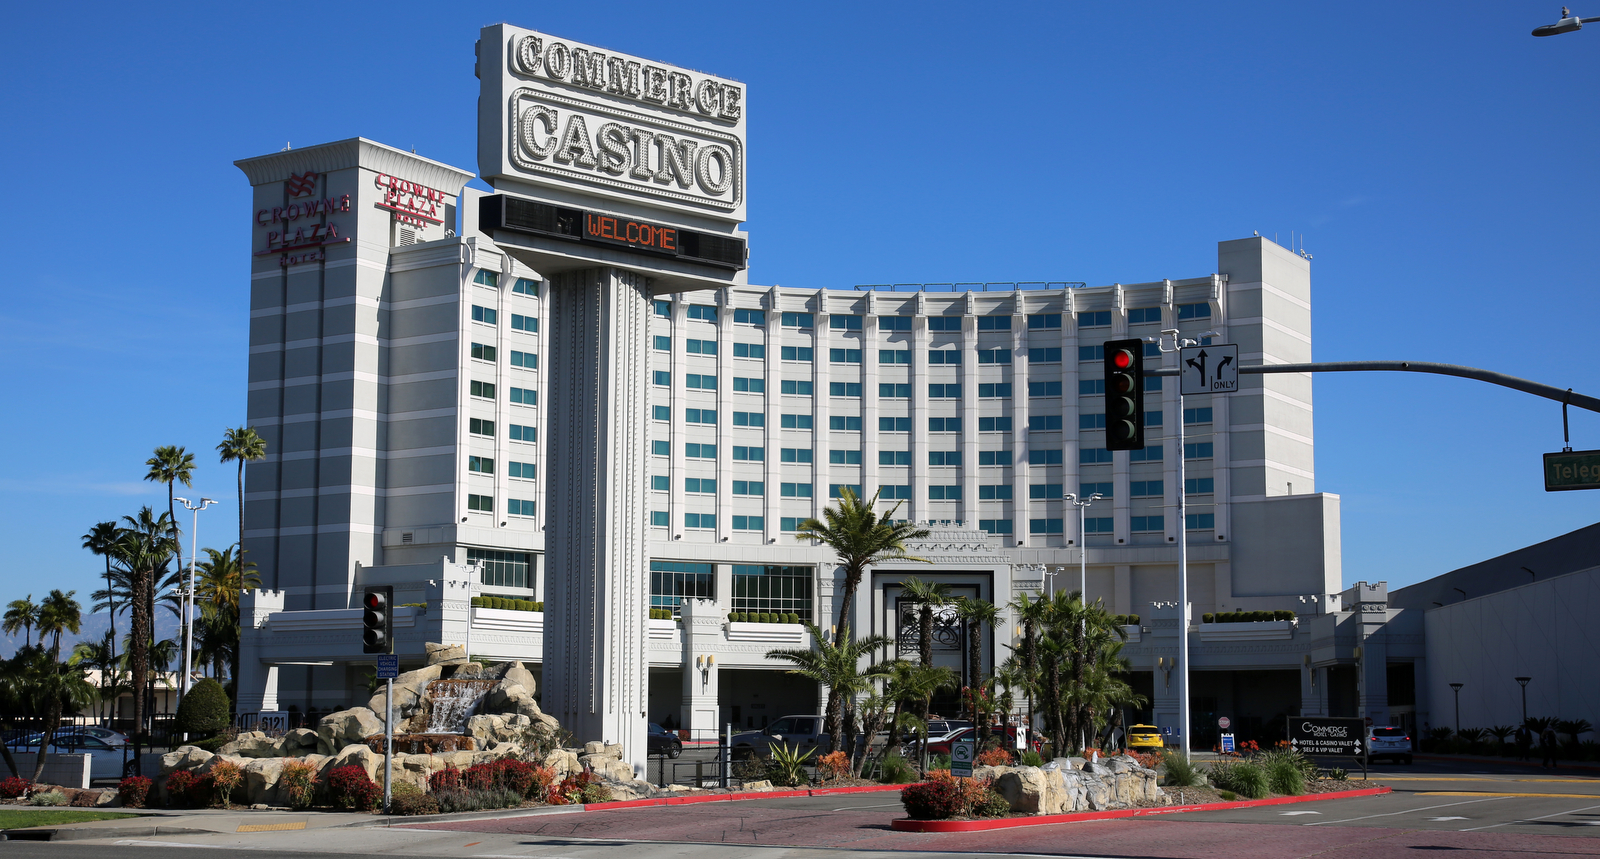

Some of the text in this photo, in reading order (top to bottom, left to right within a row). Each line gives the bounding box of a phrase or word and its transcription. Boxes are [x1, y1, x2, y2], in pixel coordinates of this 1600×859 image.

[516, 35, 742, 121] COMMERCE
[519, 105, 734, 194] CASINO
[376, 173, 446, 205] CROWNE
[255, 194, 351, 226] CROWNE
[386, 191, 437, 216] PLAZA
[395, 213, 428, 228] HOTEL
[587, 214, 676, 250] WELCOME
[266, 222, 337, 248] PLAZA
[279, 251, 325, 267] HOTEL
[1213, 380, 1236, 390] ONLY
[262, 716, 285, 731] 6121
[1302, 721, 1348, 734] COMMERCE
